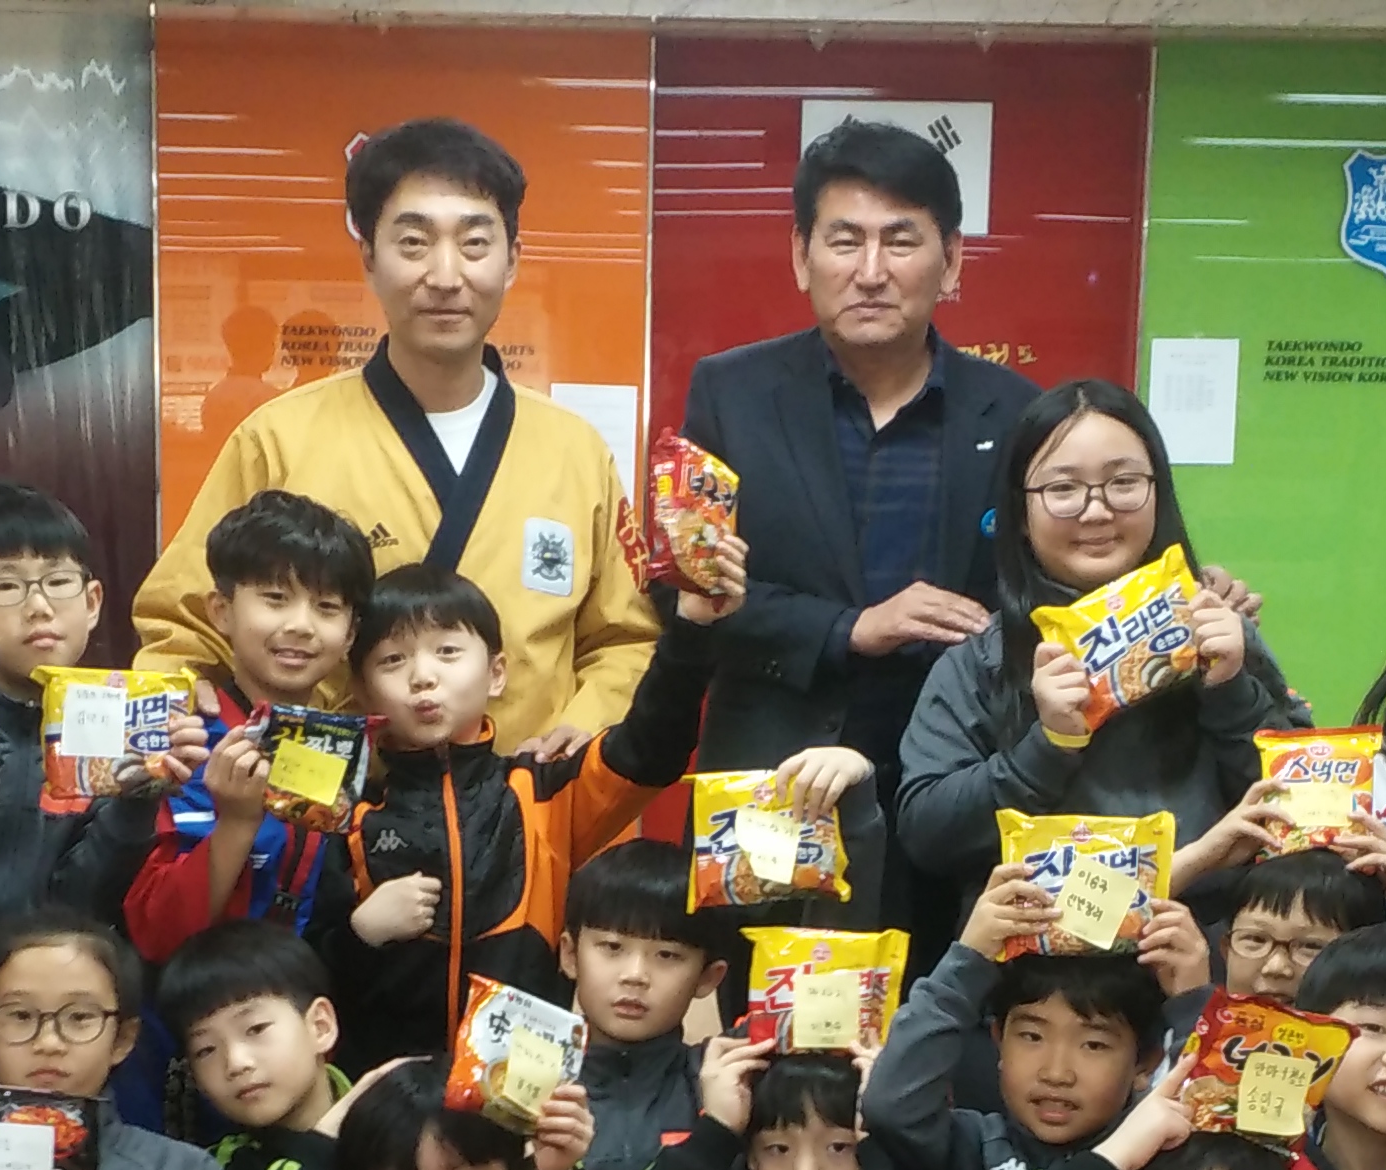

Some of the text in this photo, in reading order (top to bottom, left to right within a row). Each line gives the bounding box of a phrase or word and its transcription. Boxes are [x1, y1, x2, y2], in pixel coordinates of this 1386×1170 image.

[1266, 339, 1363, 352] TAEKWONDO
[1264, 354, 1314, 367] KOREA
[1263, 370, 1299, 382] NEW
[1303, 371, 1353, 382] VISION
[1080, 590, 1174, 674] 진라면
[1281, 757, 1360, 785] 스낵면
